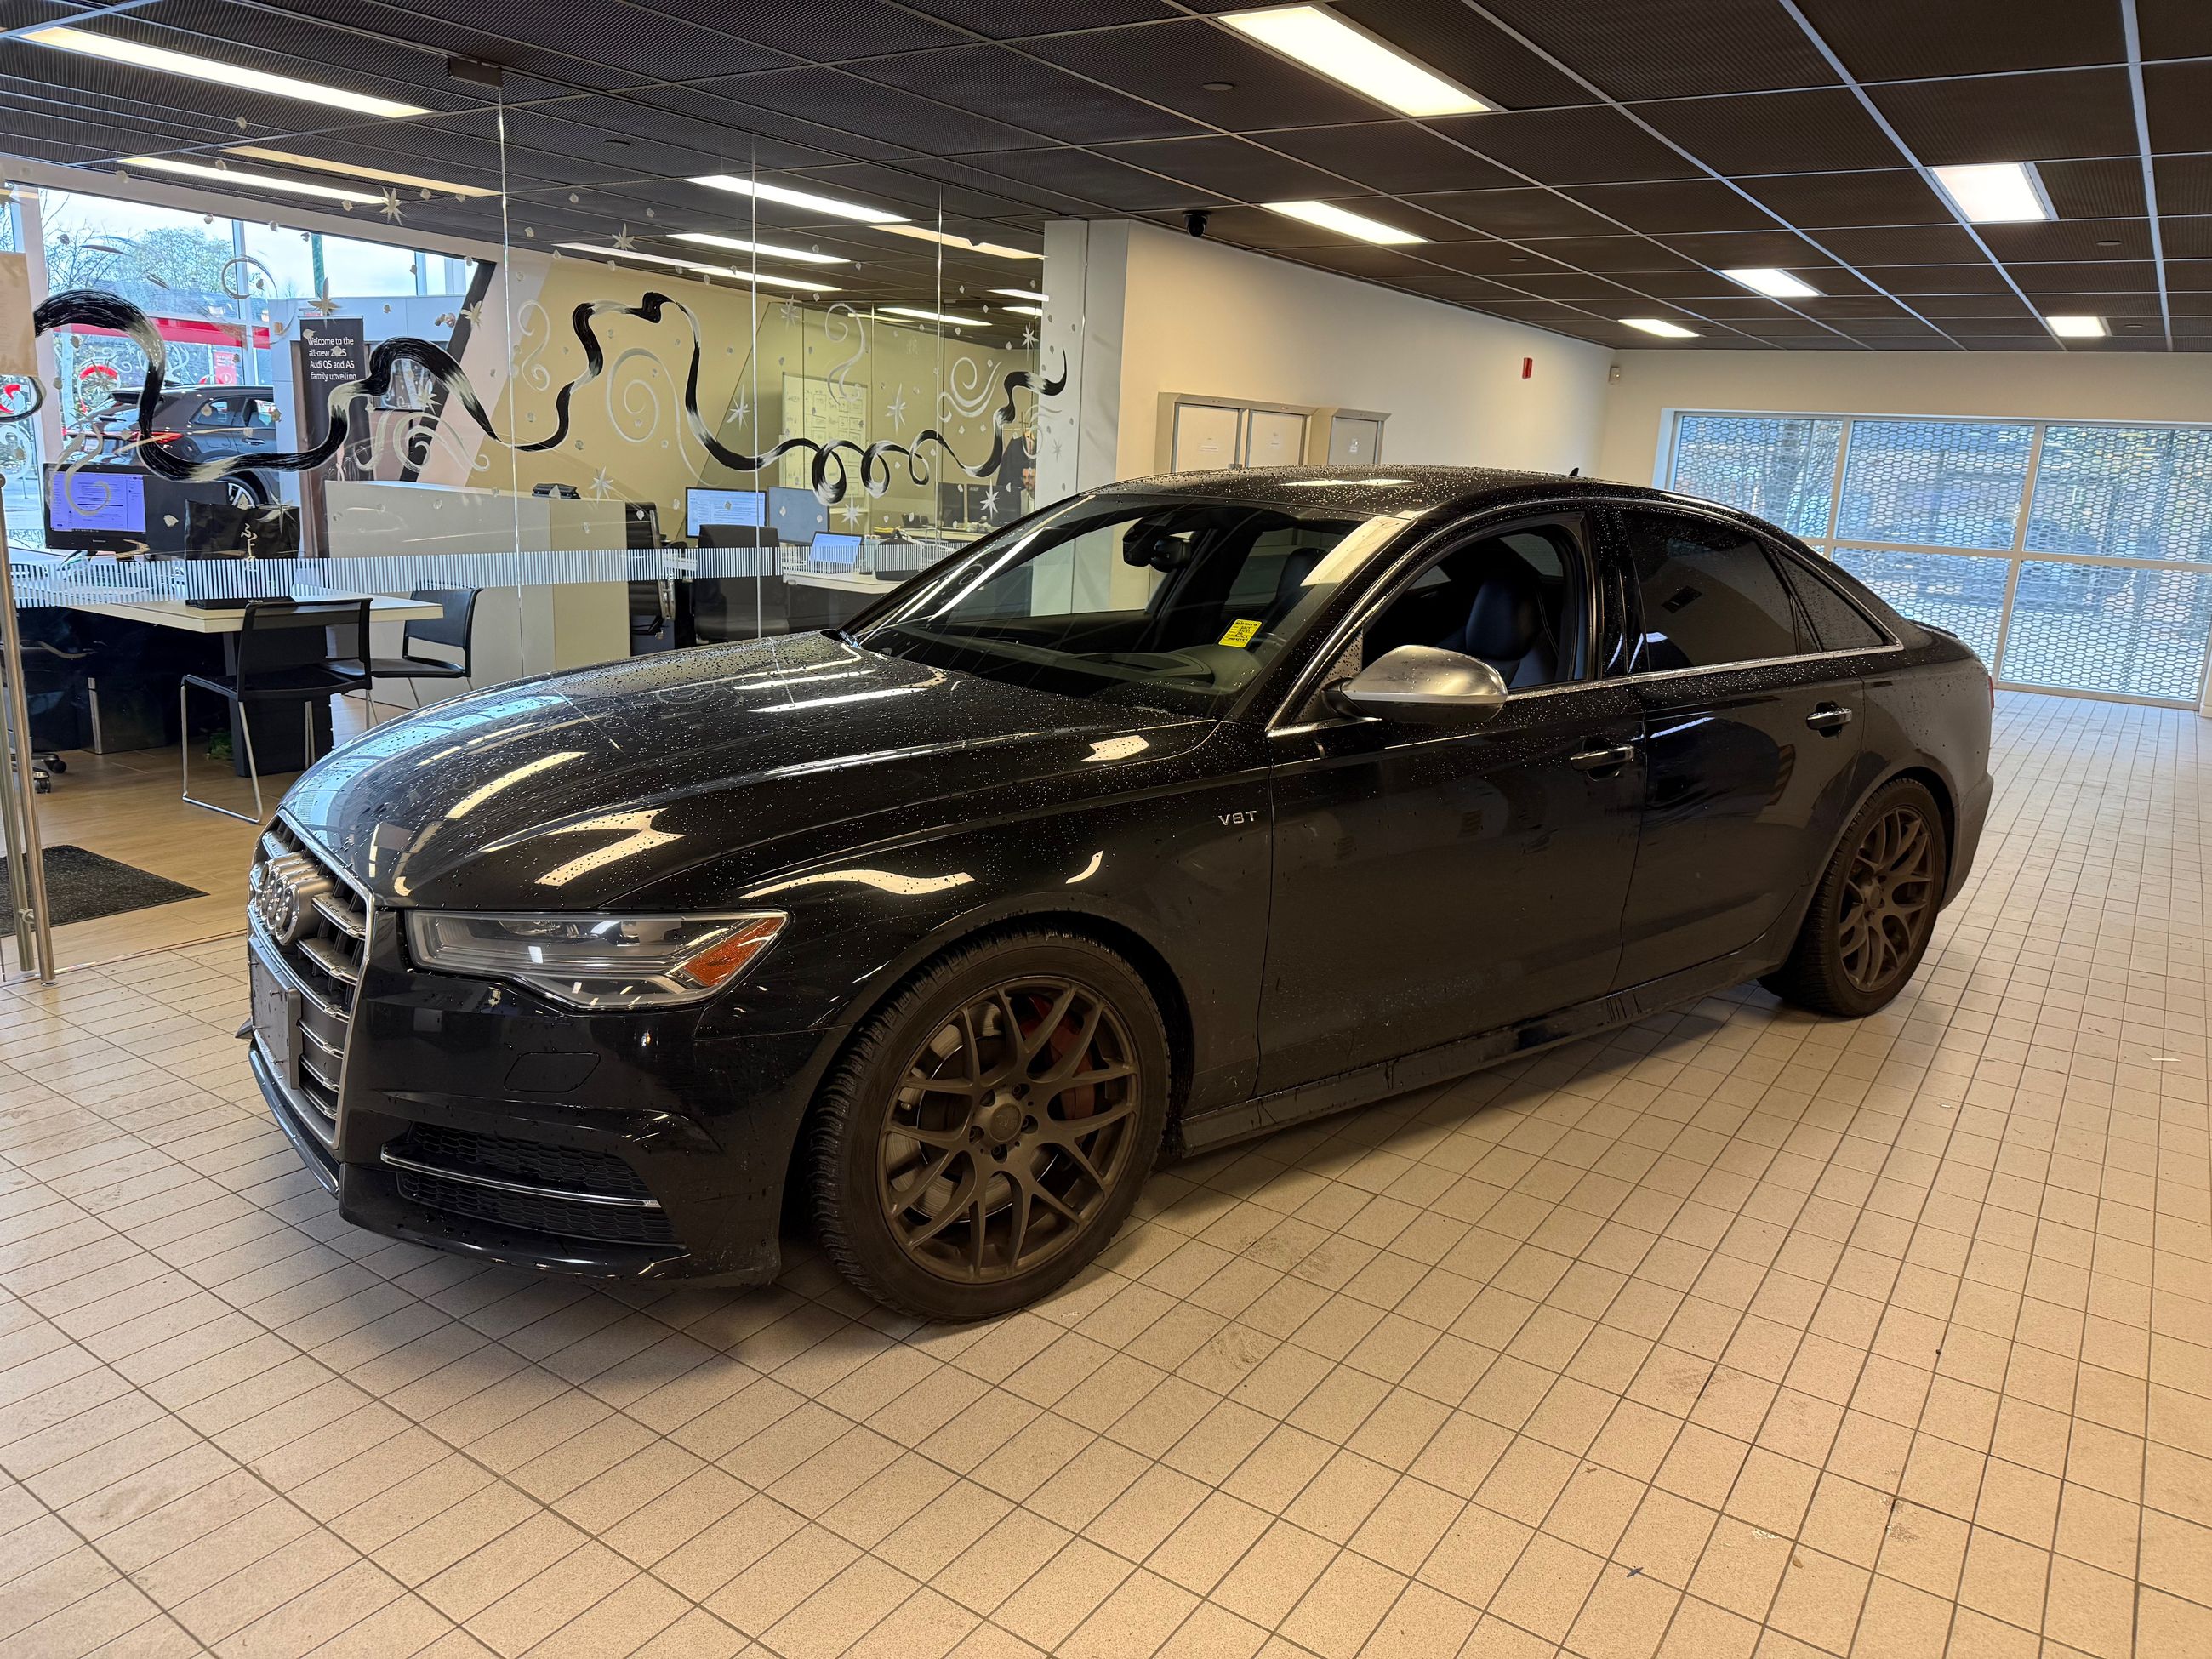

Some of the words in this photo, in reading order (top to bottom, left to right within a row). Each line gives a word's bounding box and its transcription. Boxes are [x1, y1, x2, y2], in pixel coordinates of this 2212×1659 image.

[307, 337, 334, 345] Welcome
[343, 337, 354, 345] the
[310, 360, 322, 368] Audi
[322, 360, 333, 369] Q5
[333, 360, 345, 368] and
[345, 360, 355, 368] A5
[311, 371, 328, 382] family
[1217, 810, 1257, 826] V8T
